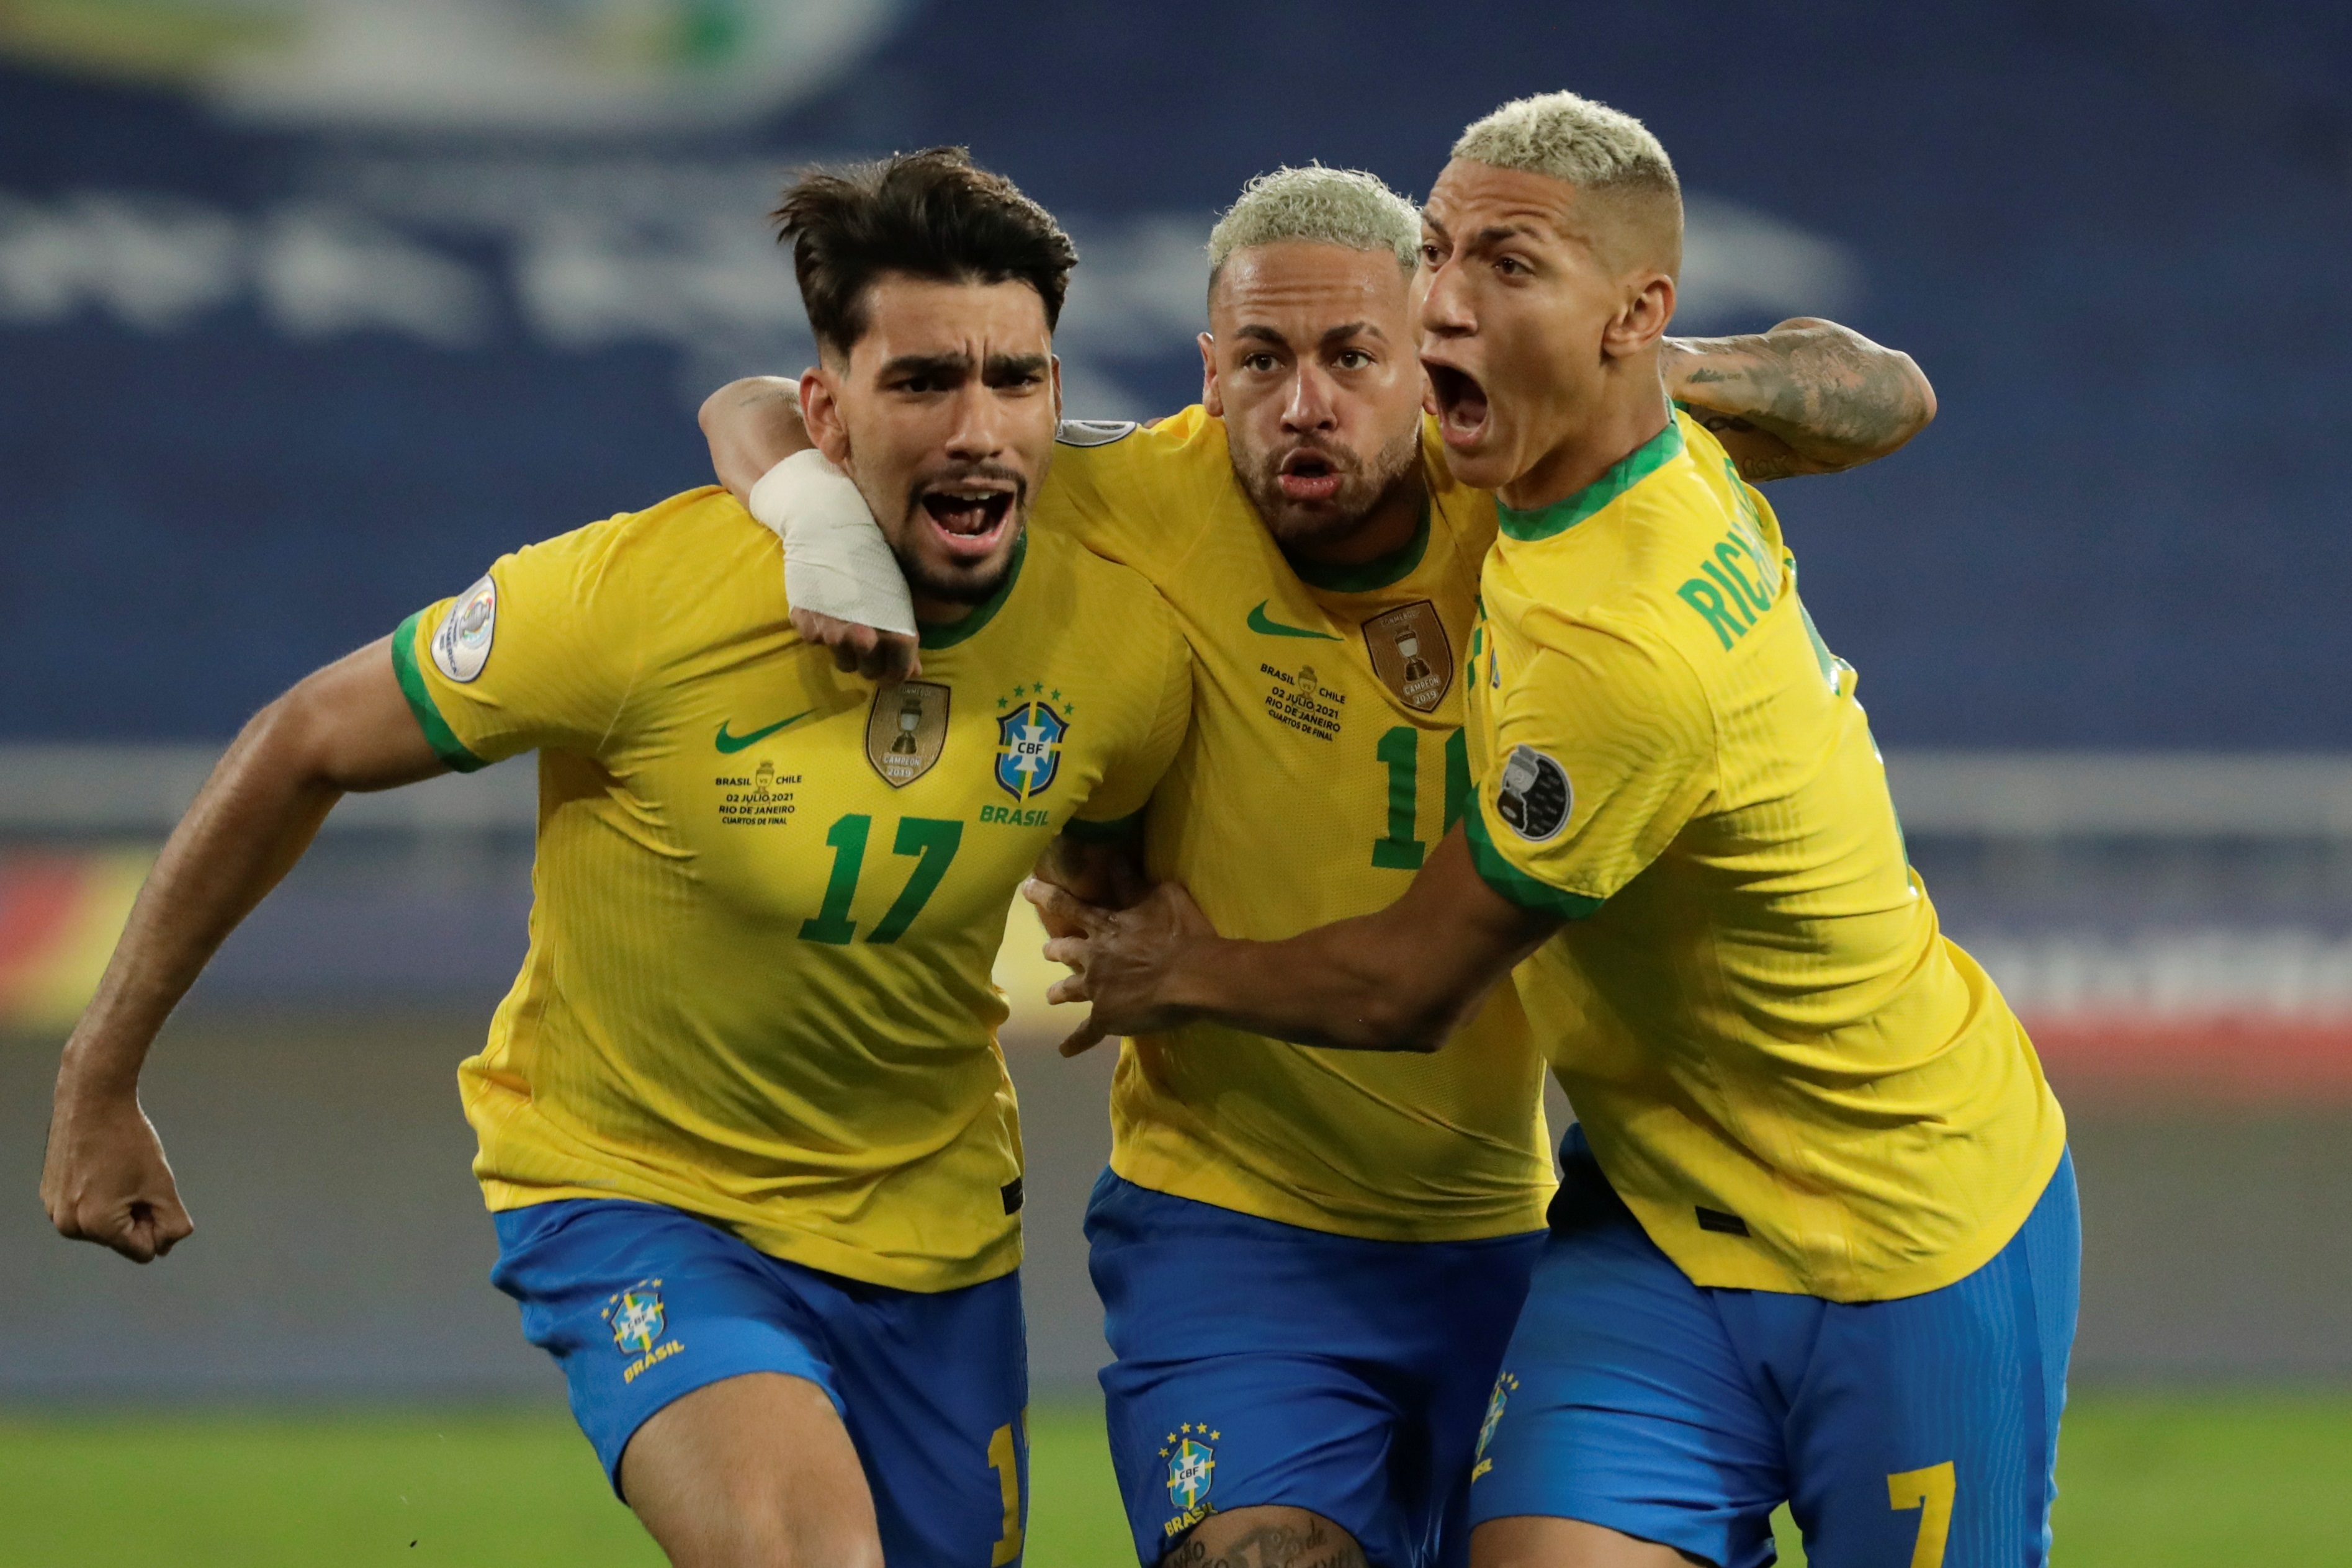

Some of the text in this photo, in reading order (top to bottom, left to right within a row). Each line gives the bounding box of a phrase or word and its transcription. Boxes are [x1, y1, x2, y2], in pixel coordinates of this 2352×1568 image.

[1260, 663, 1295, 686] BRASIL
[1319, 688, 1346, 704] CHILE
[1404, 676, 1439, 694] CAMPEON
[1272, 687, 1339, 719] 02 JULIO 2021
[1415, 691, 1437, 704] 2019
[1265, 696, 1340, 732] RIO DE JANEIRO
[1268, 709, 1333, 741] CUARTOS DE FINAL
[1017, 742, 1044, 755] CBF
[883, 755, 920, 766] CAMPEON
[716, 777, 752, 786] BRASIL
[776, 775, 802, 785] CHILE
[888, 768, 911, 777] 2019
[726, 793, 794, 802] 02 JULIO 2021
[719, 805, 795, 815] RIO DE JANEIRO
[980, 805, 1049, 827] BRASIL
[722, 817, 755, 825] CUARTOS
[797, 813, 964, 945] 17
[628, 1313, 647, 1330] CBF
[624, 1340, 685, 1384] BRASIL
[1179, 1466, 1200, 1480] CBF
[987, 1404, 1029, 1568] 1
[1164, 1502, 1218, 1538] BRASIL
[1887, 1460, 1957, 1568] 7
